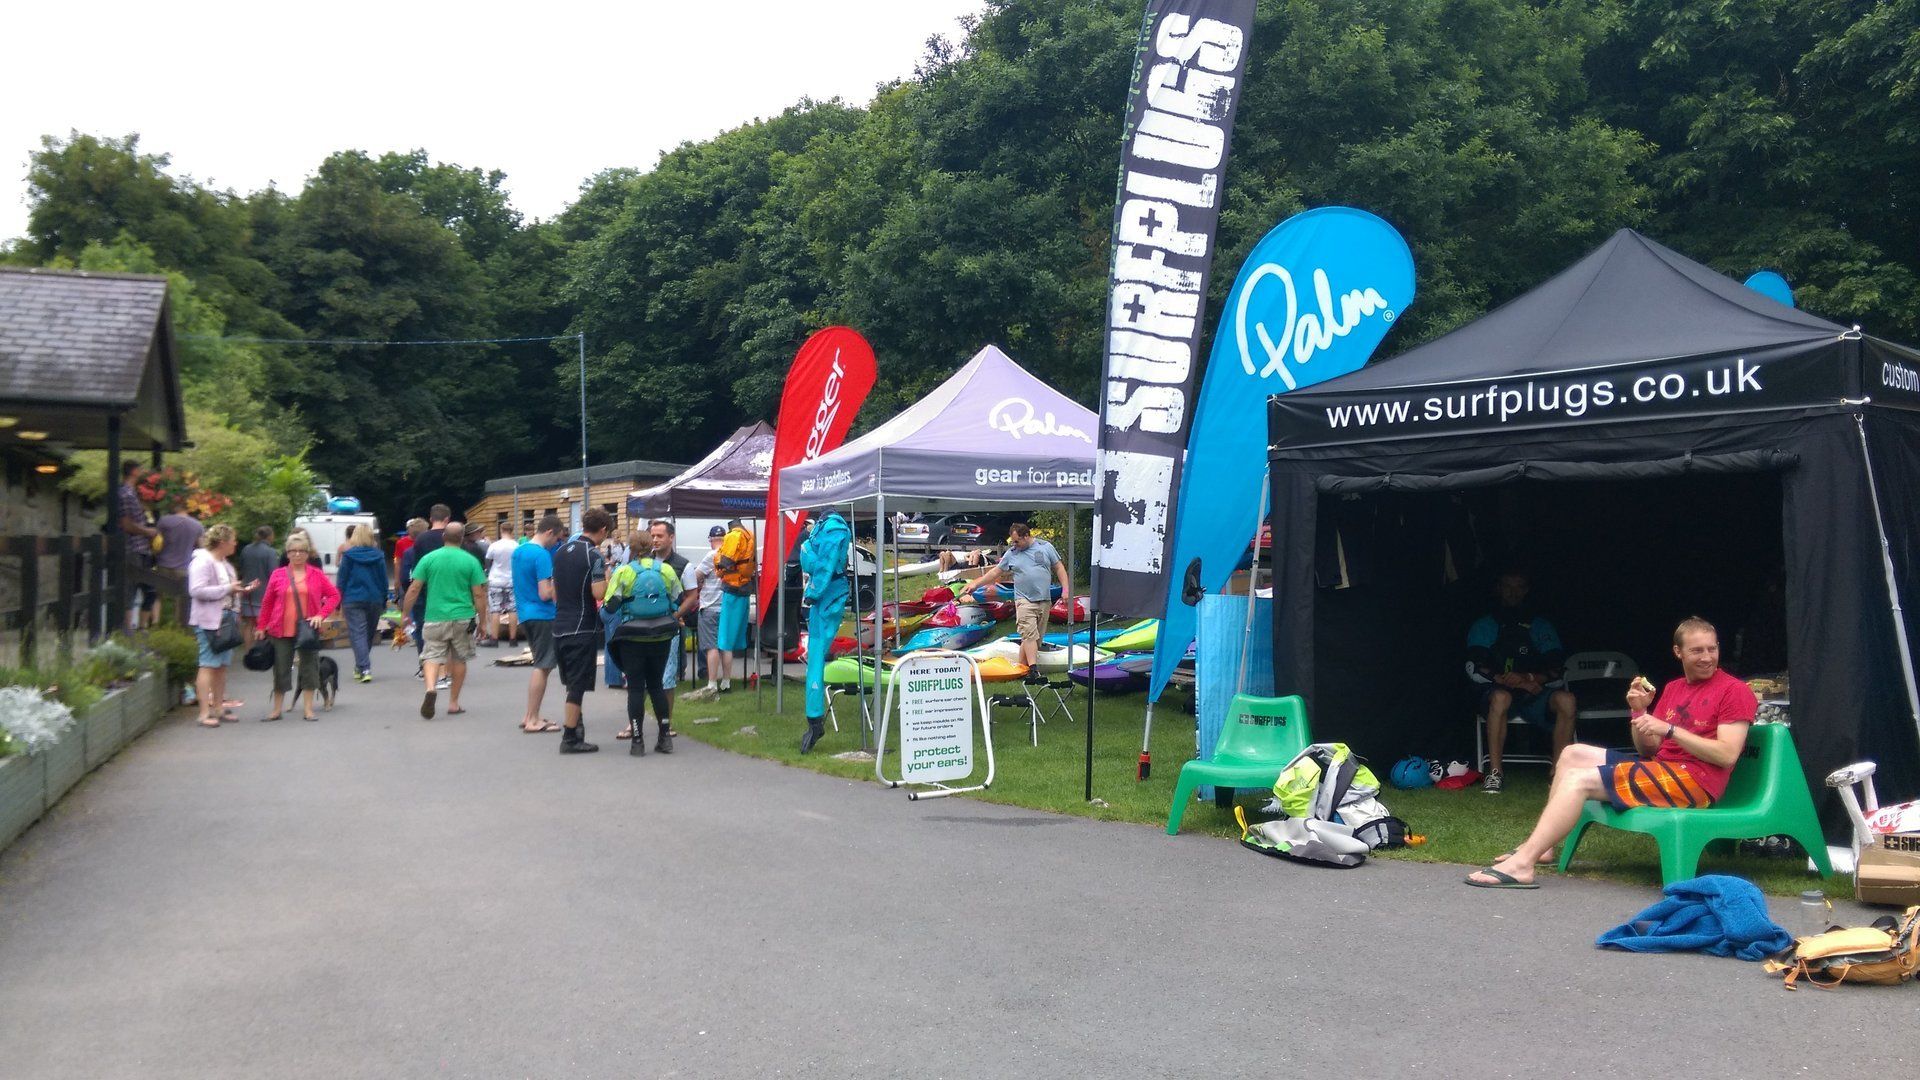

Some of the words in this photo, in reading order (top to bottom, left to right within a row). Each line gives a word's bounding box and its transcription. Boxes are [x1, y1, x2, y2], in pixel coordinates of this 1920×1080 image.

[1106, 12, 1244, 433] SURFPLUGS
[1236, 263, 1388, 391] Palm
[1882, 362, 1920, 392] custom
[1326, 358, 1763, 429] www.surfplugs.co.uk
[988, 397, 1092, 444] Palm
[975, 468, 1022, 485] gear
[1027, 467, 1051, 484] for
[801, 478, 816, 495] gear
[909, 668, 931, 676] HERE
[935, 666, 961, 674] TODAY!
[908, 677, 964, 693] SURFPLUGS
[913, 744, 961, 760] protect
[907, 761, 935, 774] your
[937, 755, 968, 768] ears!
